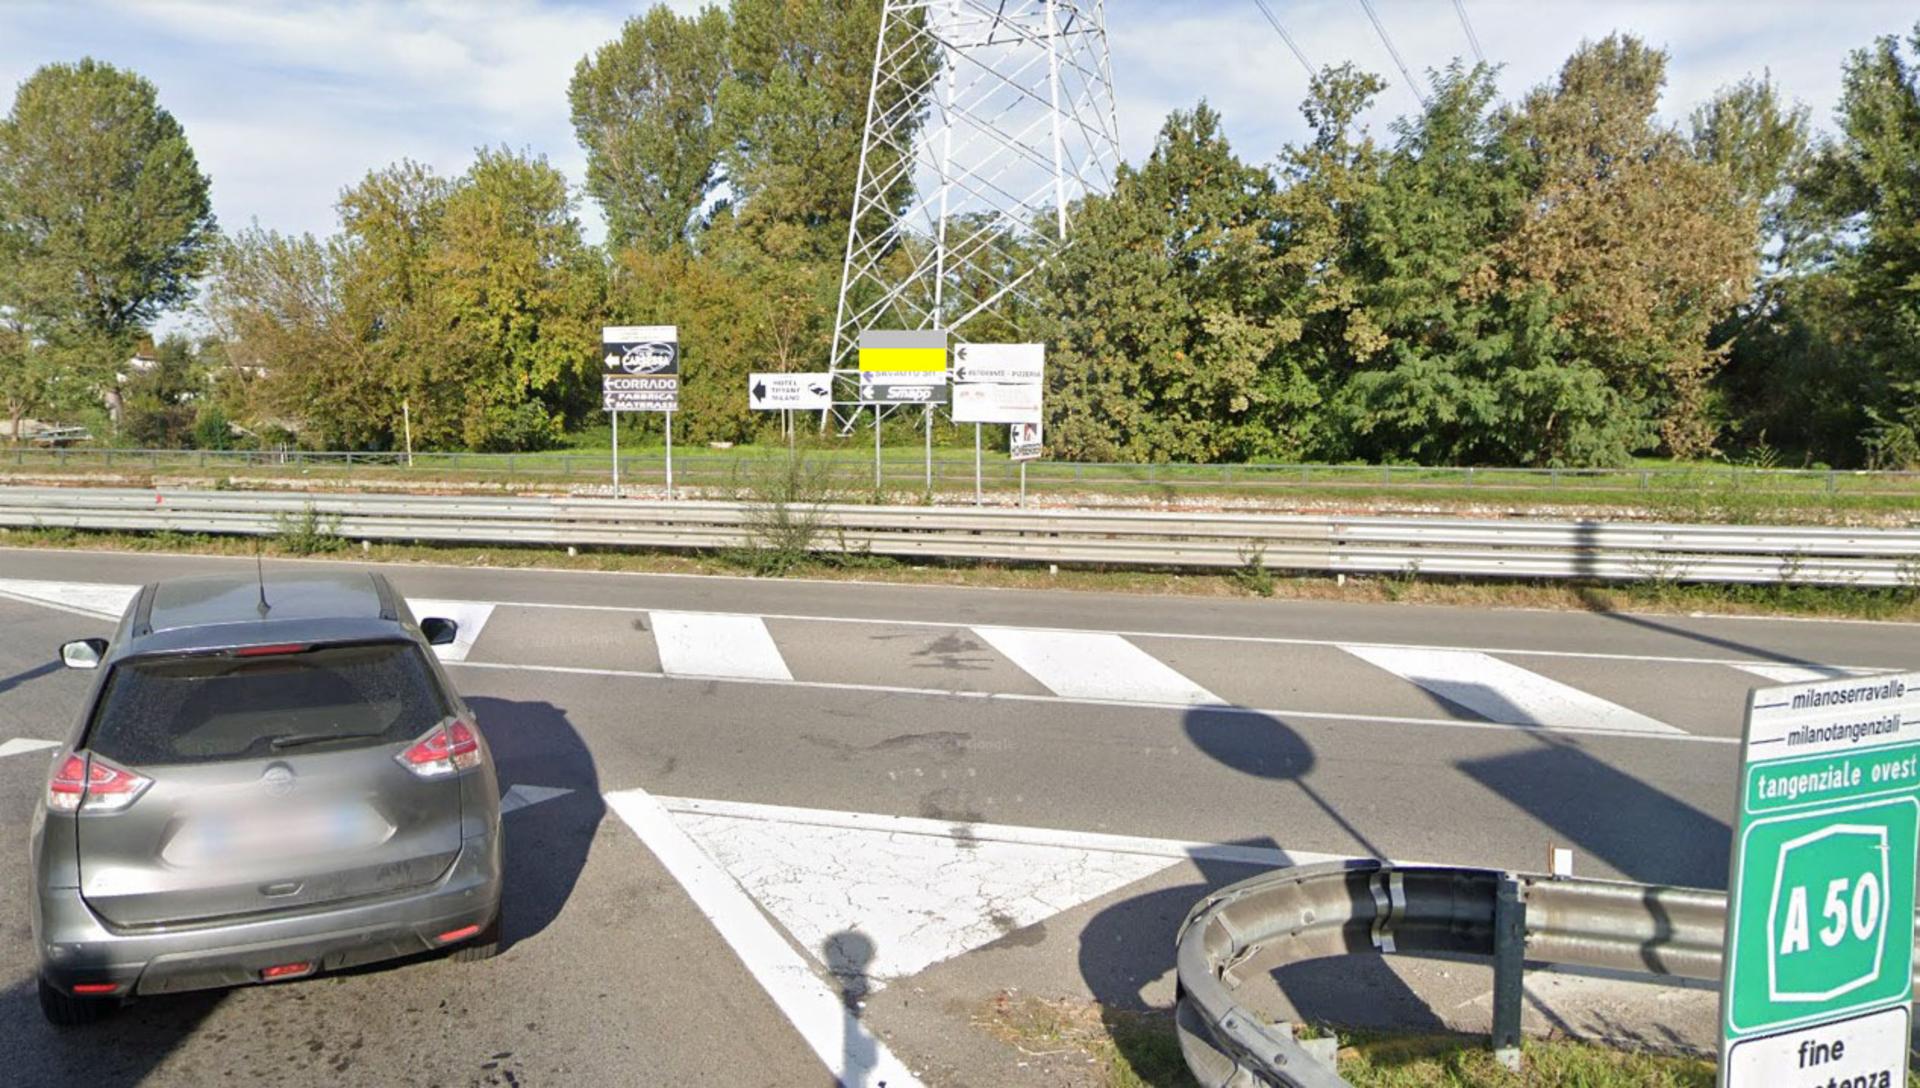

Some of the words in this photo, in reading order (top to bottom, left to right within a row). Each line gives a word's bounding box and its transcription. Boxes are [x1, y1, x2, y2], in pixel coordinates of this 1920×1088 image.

[614, 378, 677, 390] CORRADO
[618, 392, 674, 401] FABBRICA
[614, 401, 678, 410] MATERASSI
[1791, 680, 1905, 710] milanoserravalle
[1787, 714, 1901, 747] milanotangenziali
[1758, 761, 1862, 800] tangenziale
[1871, 753, 1917, 783] ovest
[1780, 885, 1810, 955] A
[1819, 872, 1880, 948] 50
[1798, 1039, 1845, 1069] fine
